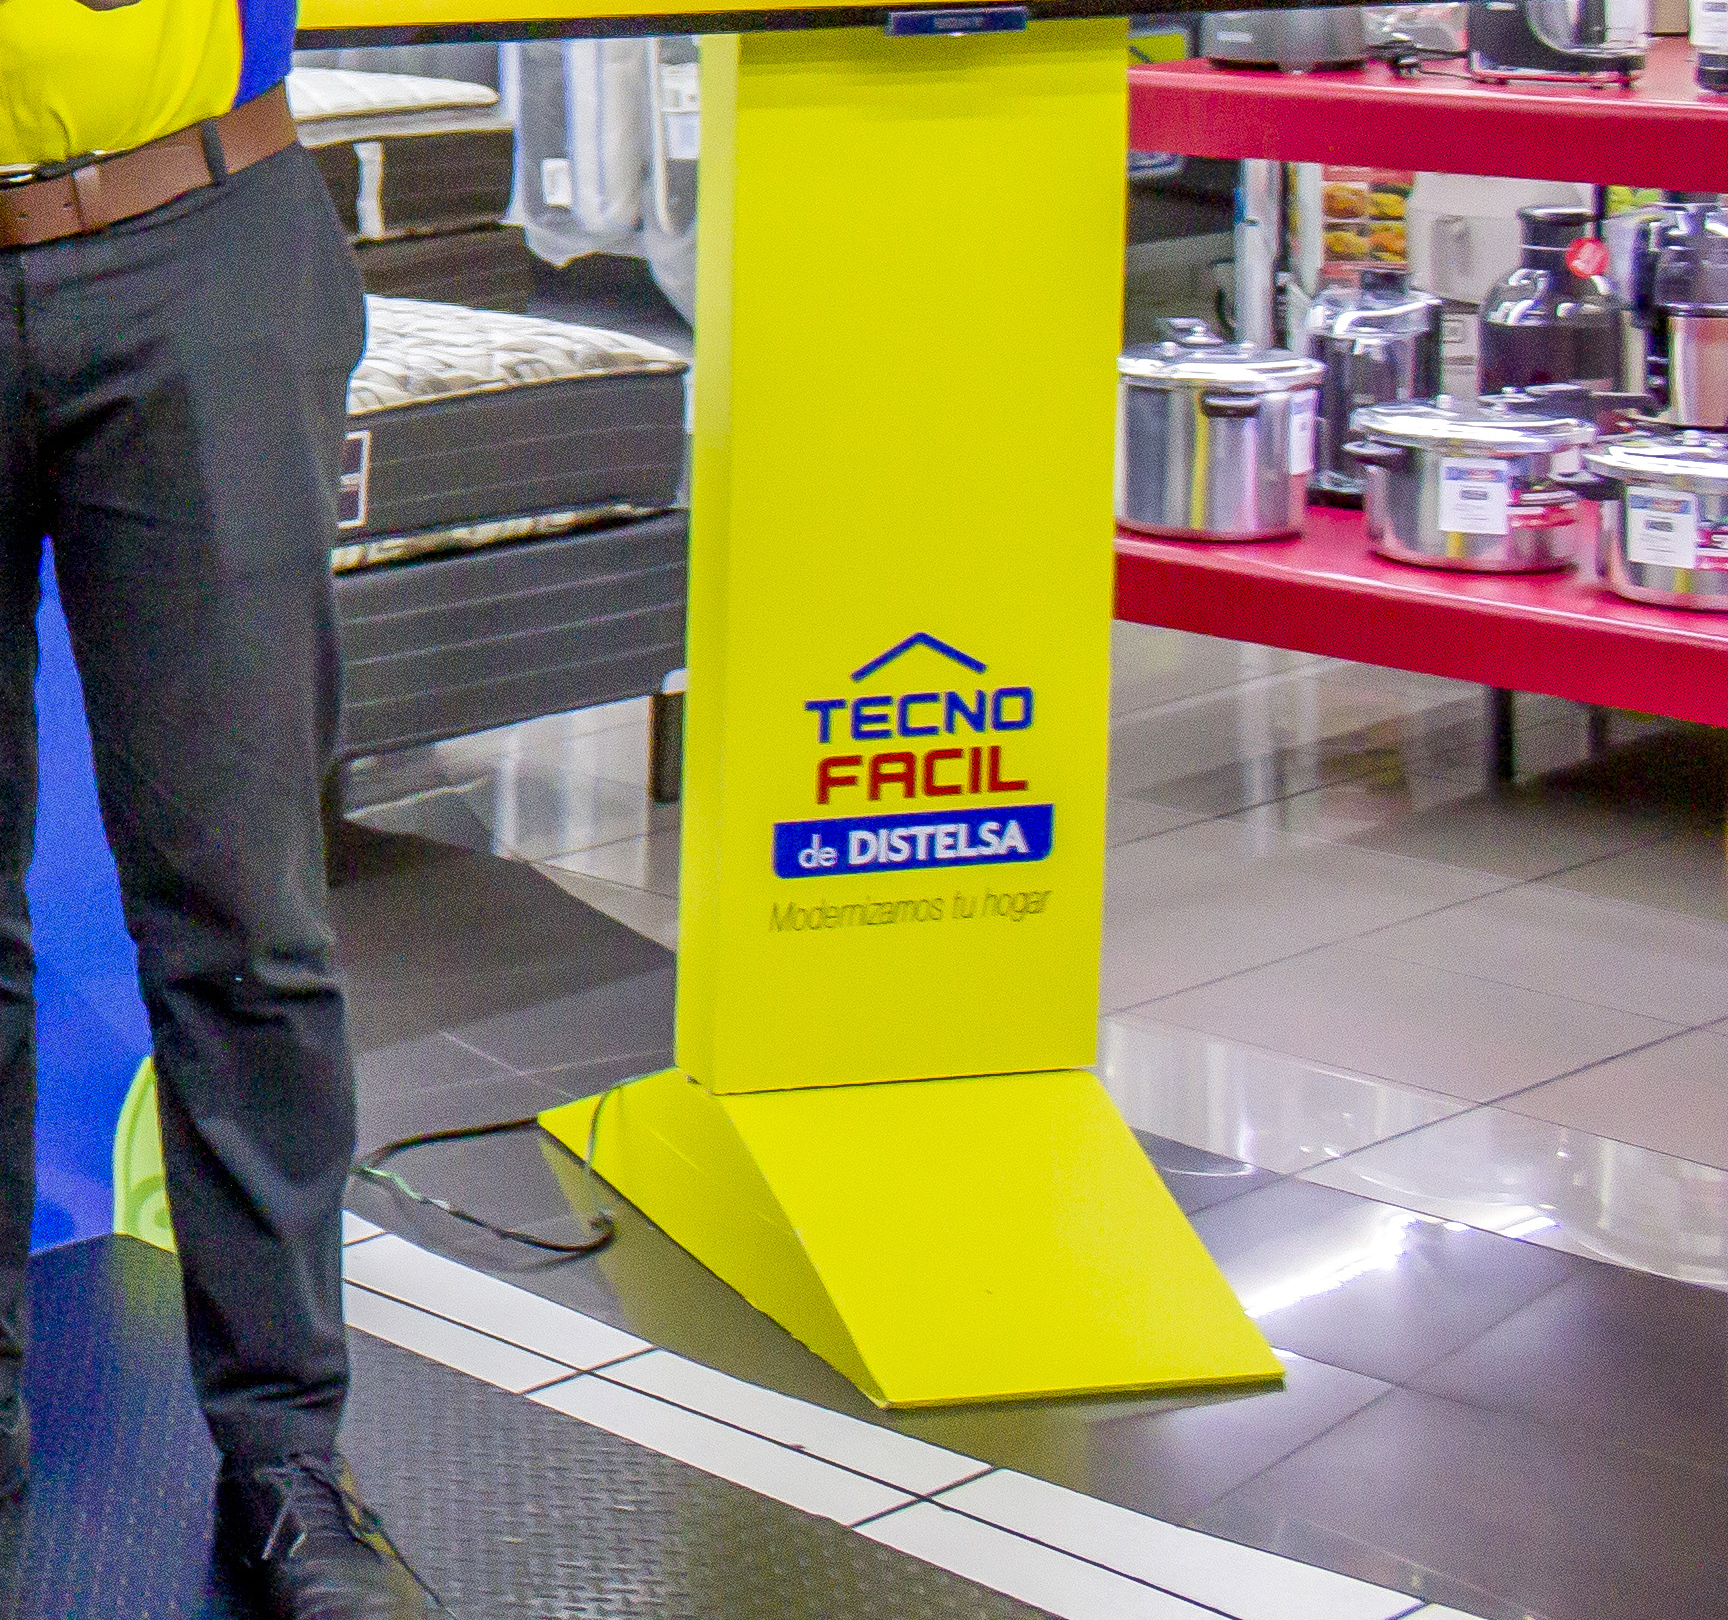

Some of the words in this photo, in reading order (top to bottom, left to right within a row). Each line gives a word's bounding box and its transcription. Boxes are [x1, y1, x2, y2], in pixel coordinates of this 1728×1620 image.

[804, 685, 1033, 743] TECNO
[815, 745, 1028, 805] FACIL
[798, 833, 838, 869] de
[848, 820, 1030, 866] DISTELSA
[769, 894, 945, 933] Modernizamos
[950, 890, 977, 920] tu
[980, 887, 1054, 923] hogar
